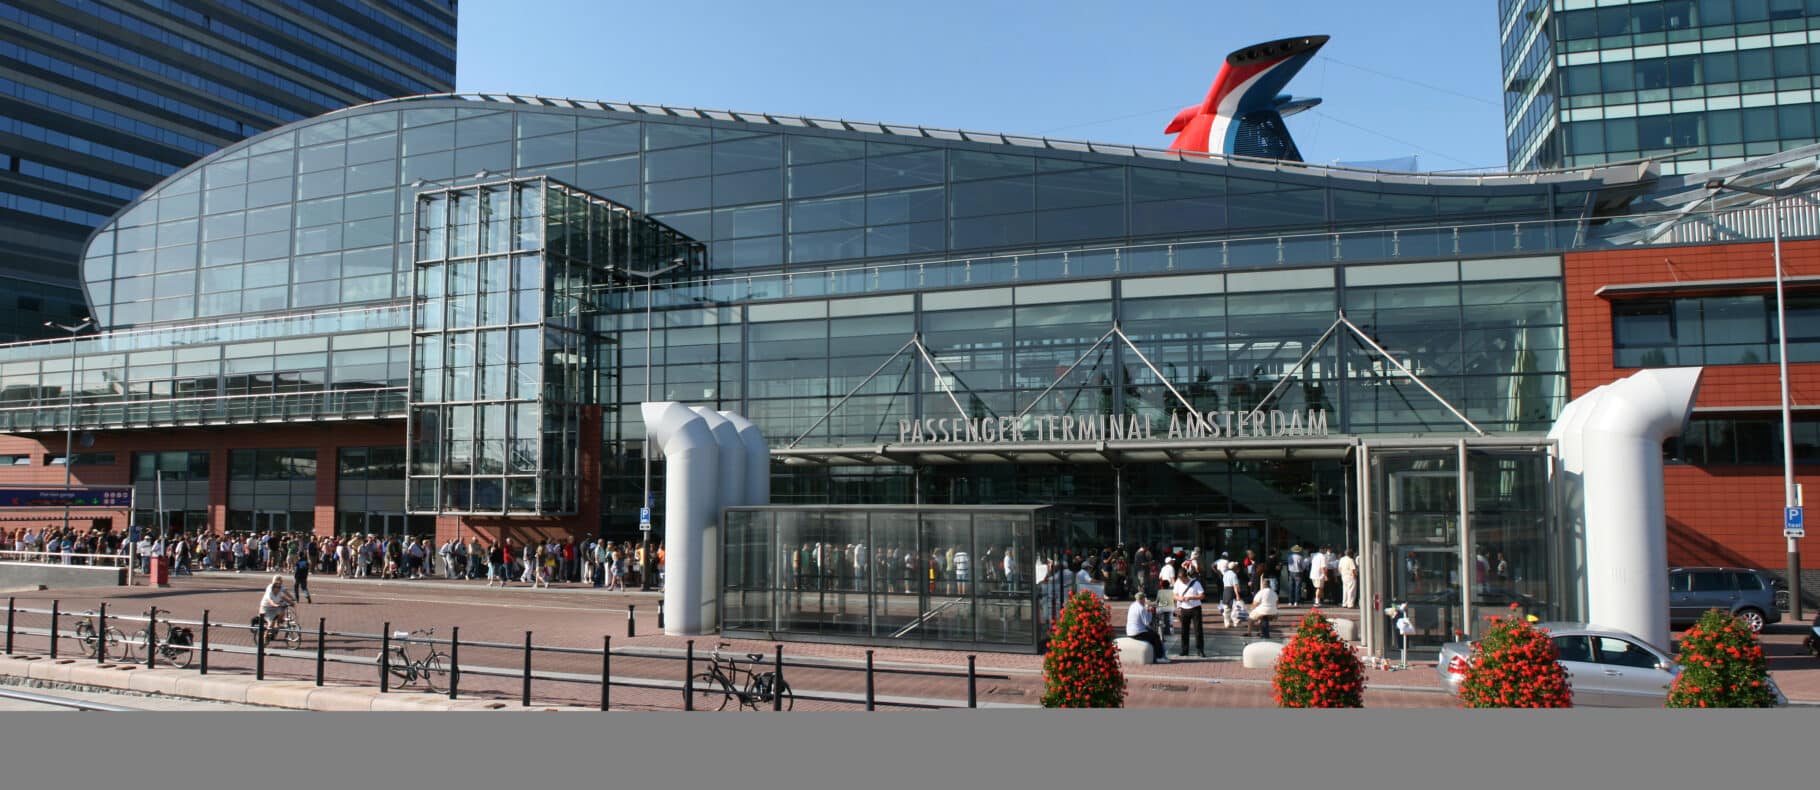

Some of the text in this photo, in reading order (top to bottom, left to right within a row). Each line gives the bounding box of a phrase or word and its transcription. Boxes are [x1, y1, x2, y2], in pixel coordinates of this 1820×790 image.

[899, 408, 1329, 444] PASSENGER TERMINAL AMSTERDAM
[643, 509, 649, 519] P
[1789, 509, 1799, 521] P
